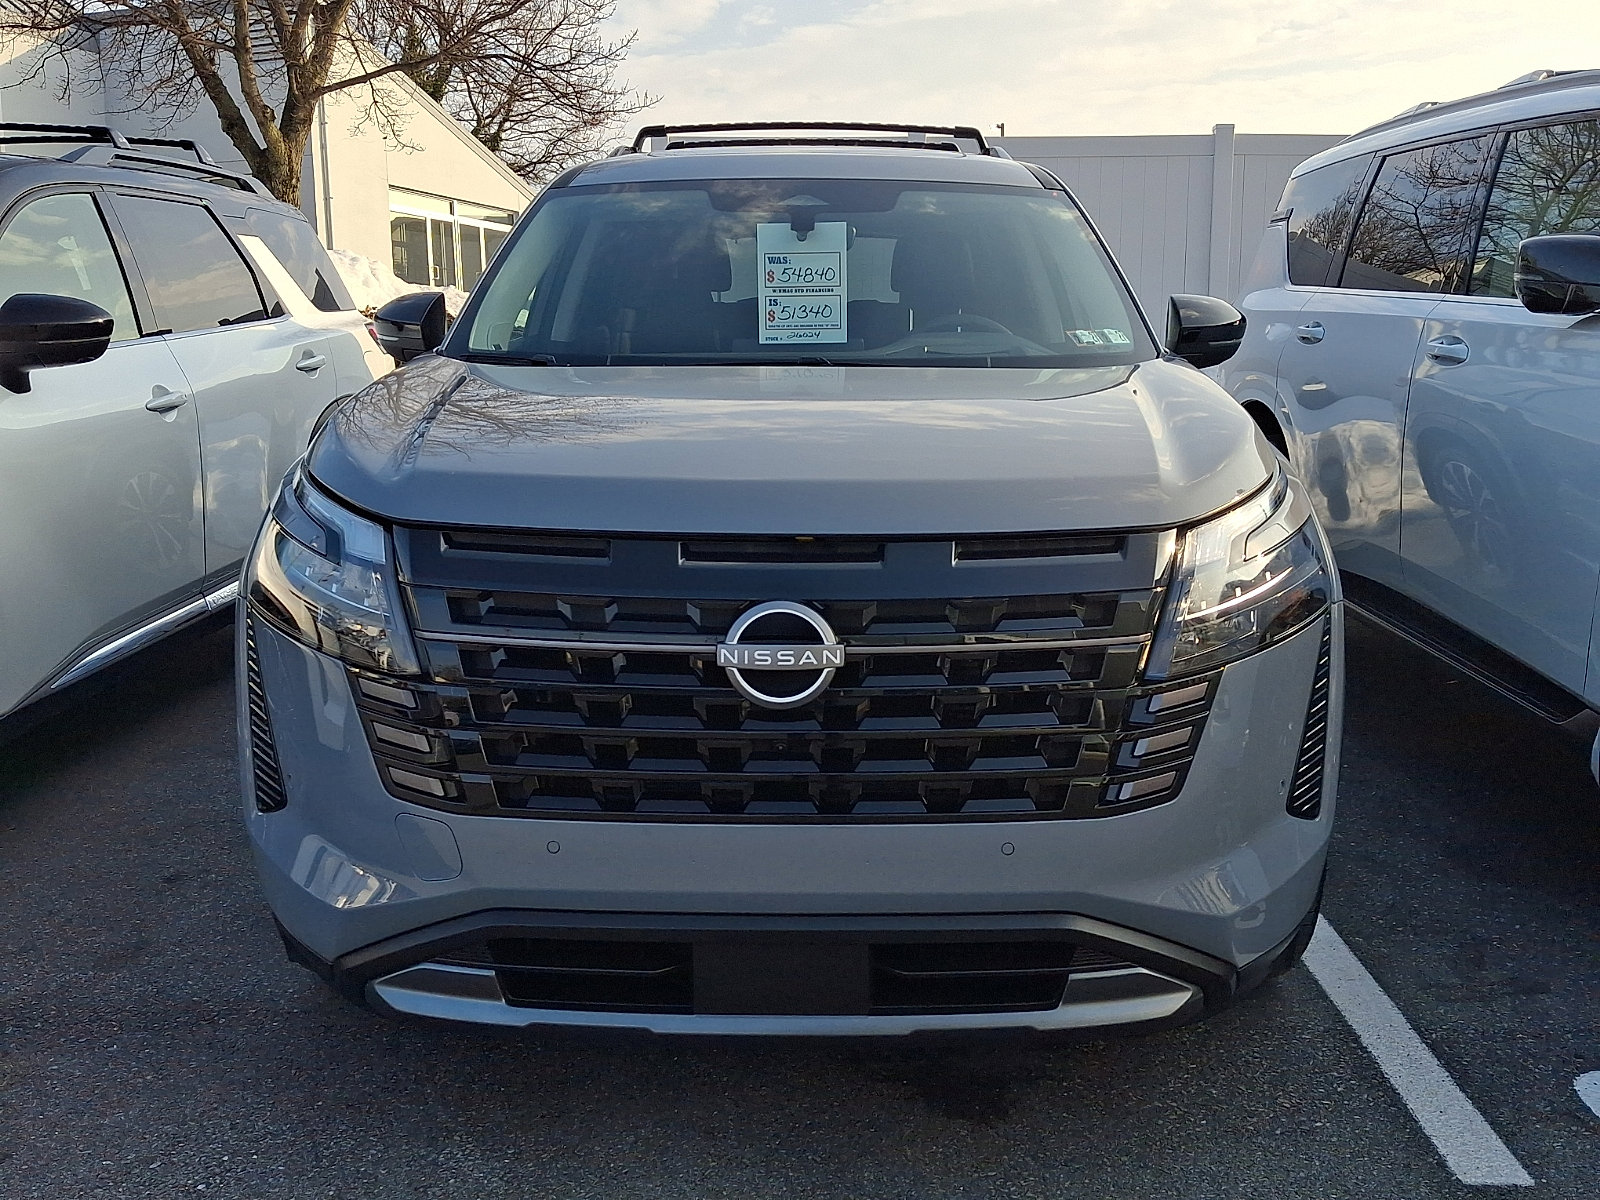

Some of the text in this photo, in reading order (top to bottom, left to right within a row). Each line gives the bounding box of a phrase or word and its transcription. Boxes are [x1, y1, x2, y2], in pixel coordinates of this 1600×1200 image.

[767, 256, 791, 265] WAS:
[767, 267, 836, 283] $ 54840
[768, 298, 782, 307] IS:
[768, 304, 833, 323] $ 51340
[786, 330, 821, 340] 26024
[720, 648, 841, 666] NISSAN
